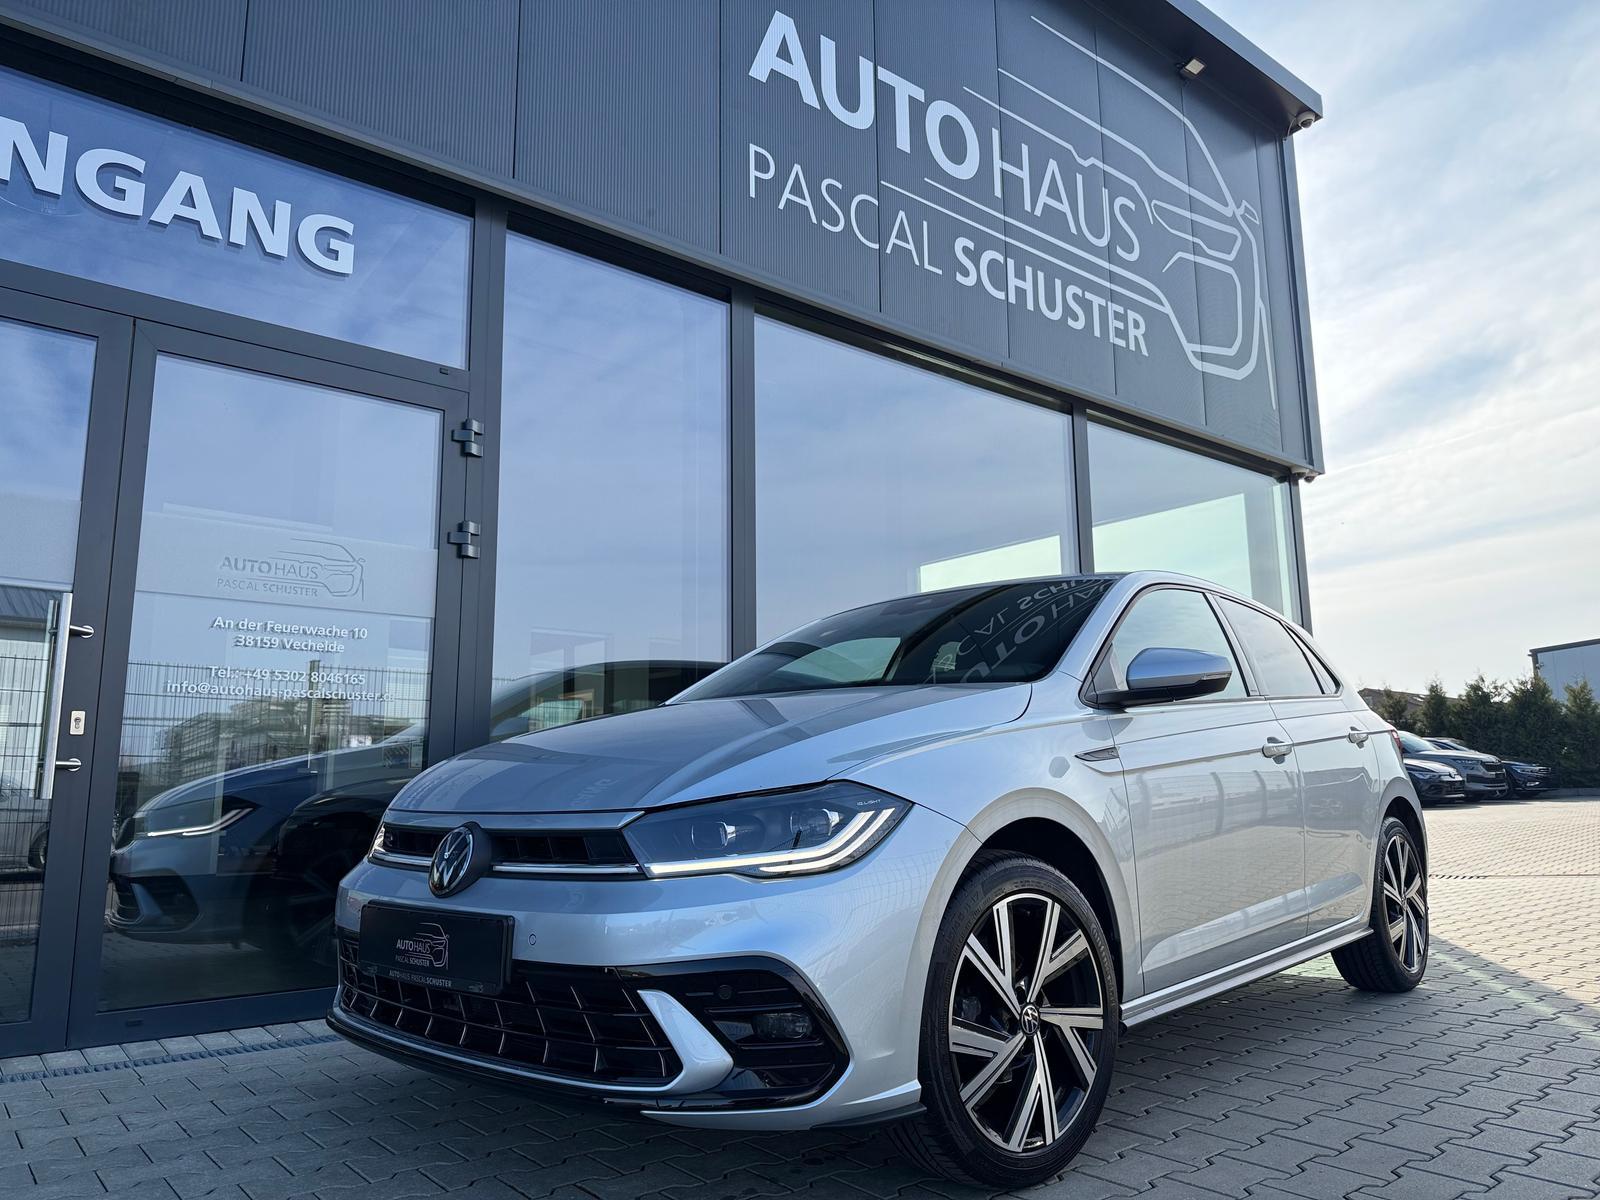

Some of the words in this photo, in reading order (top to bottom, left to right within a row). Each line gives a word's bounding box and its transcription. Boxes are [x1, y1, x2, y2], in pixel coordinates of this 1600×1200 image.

[0, 115, 355, 275] NGANG
[749, 143, 943, 275] PASCAL
[953, 236, 1149, 357] SCHUSTER
[219, 556, 319, 580] AUTOHAUS
[216, 578, 260, 592] PASCAL
[262, 583, 318, 597] SCHUSTER
[212, 616, 234, 629] An
[238, 617, 263, 631] der
[266, 620, 349, 638] Feuerwache
[352, 627, 369, 639] 10
[236, 634, 279, 648] 38159
[284, 637, 345, 653] Vechelde
[244, 668, 270, 681] +49
[274, 670, 306, 683] 5302
[310, 671, 366, 685] 8046165
[395, 938, 431, 953] AUTOHAUS
[395, 954, 409, 964] PASCAL
[409, 957, 430, 967] SCHUSTER
